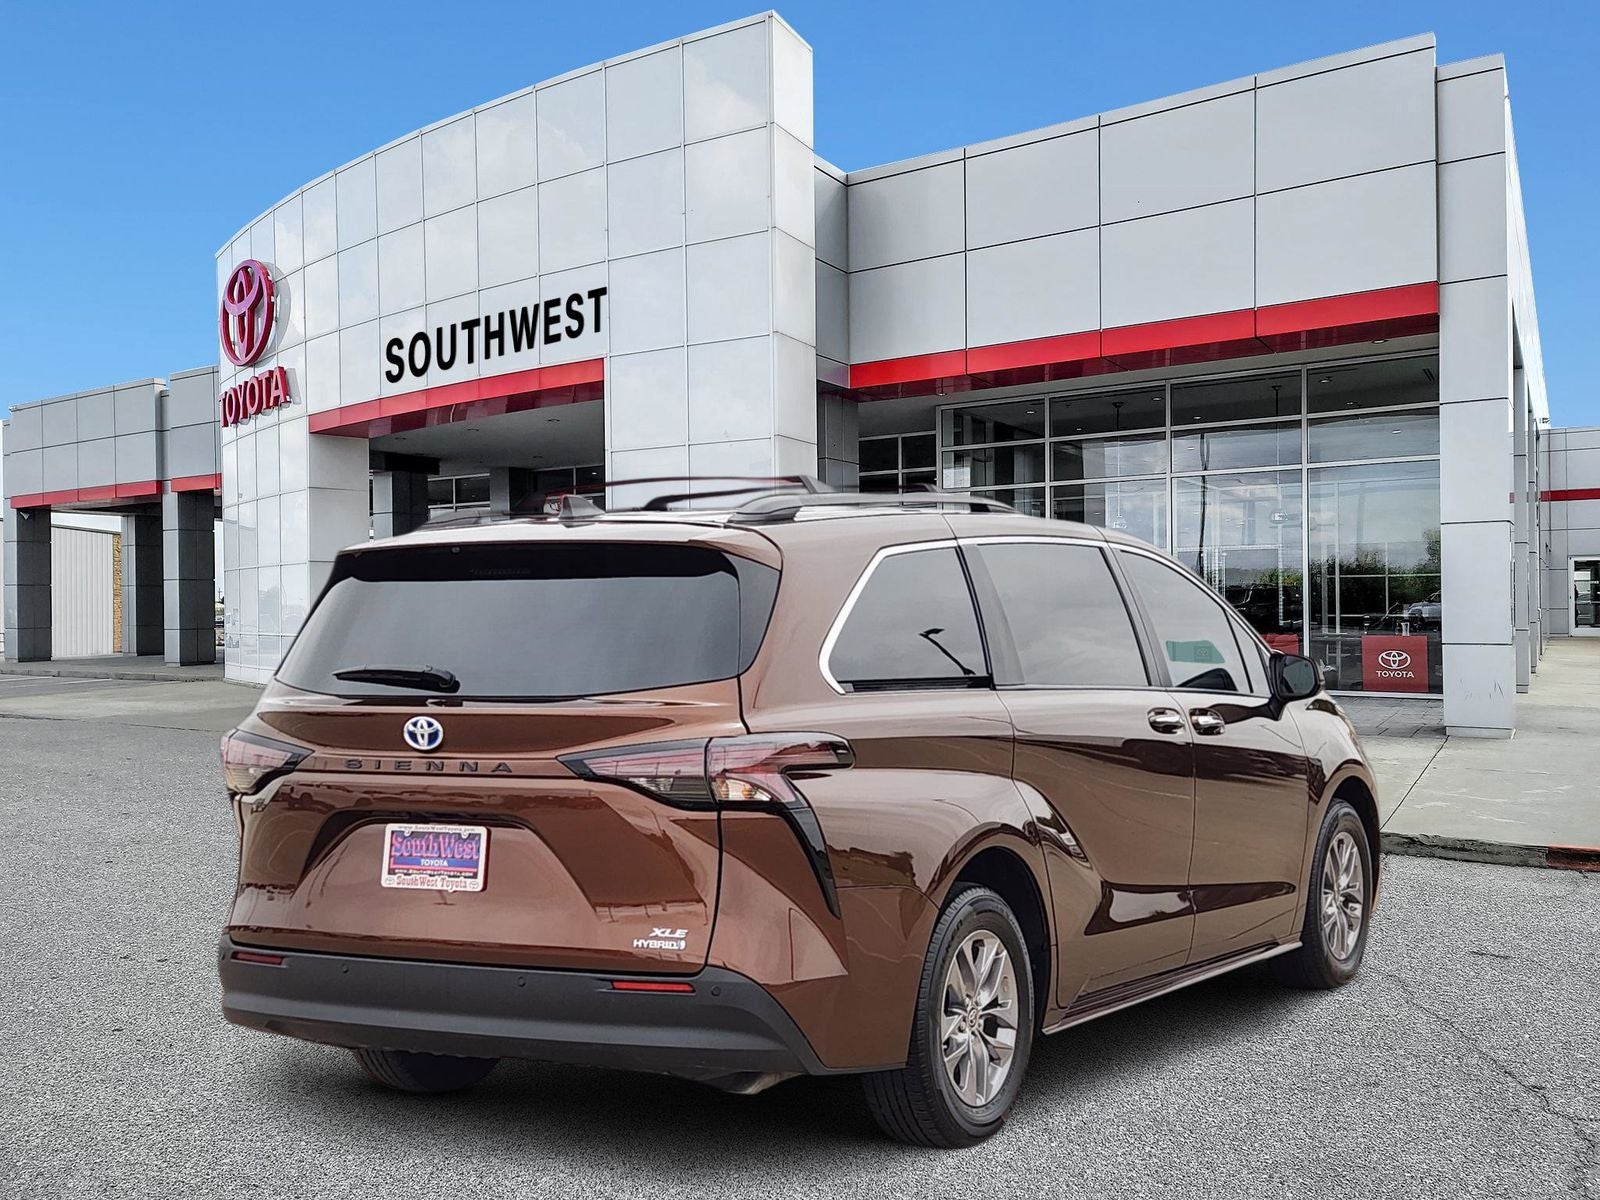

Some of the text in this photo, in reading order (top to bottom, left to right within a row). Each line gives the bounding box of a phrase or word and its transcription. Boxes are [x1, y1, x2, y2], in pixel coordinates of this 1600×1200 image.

[385, 286, 608, 384] SOUTHWEST
[219, 366, 291, 428] TOYOTA
[1376, 670, 1415, 678] TOYOTA
[345, 758, 513, 773] SIENNA
[420, 859, 448, 867] TOYOTA
[440, 877, 468, 890] Toyota
[649, 927, 689, 938] XLE
[633, 939, 677, 949] HYBRID
